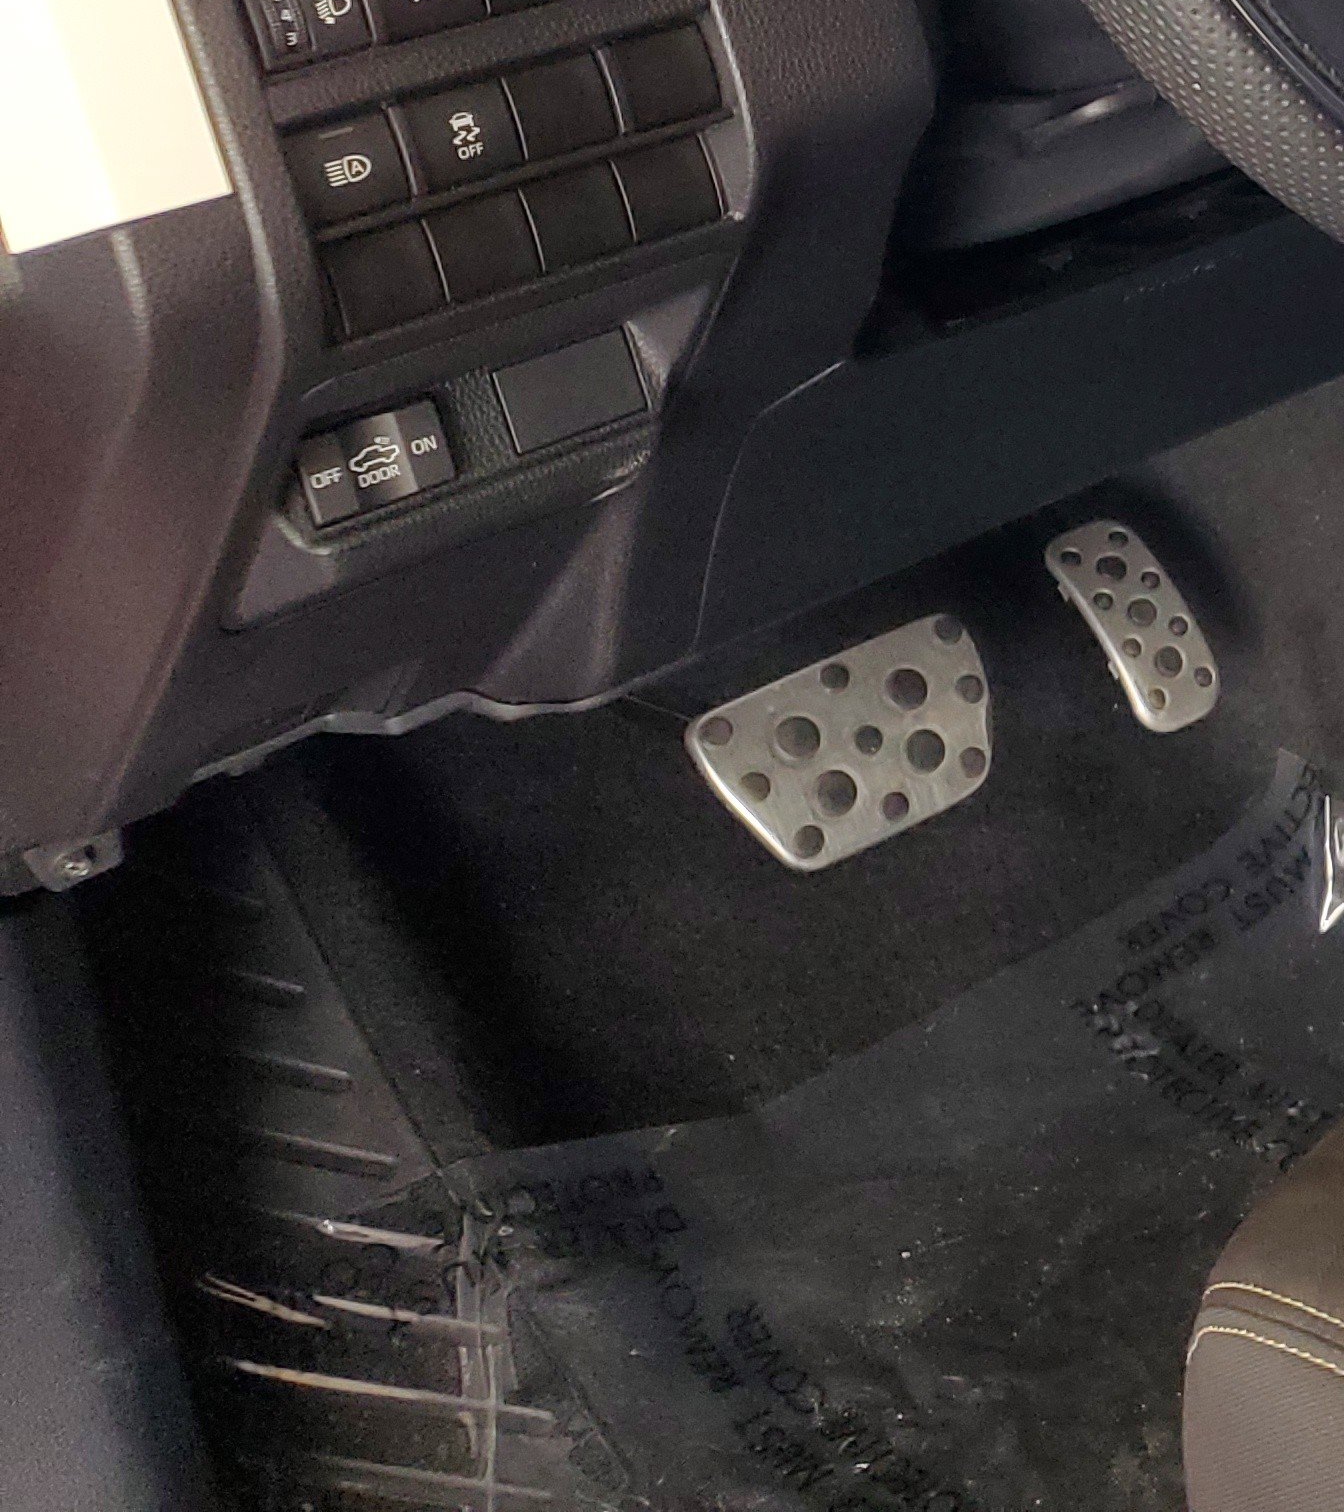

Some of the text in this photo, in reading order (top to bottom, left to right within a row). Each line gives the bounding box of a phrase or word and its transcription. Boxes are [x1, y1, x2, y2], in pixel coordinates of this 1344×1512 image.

[285, 32, 299, 47] 3
[456, 142, 485, 160] OFF
[410, 435, 438, 456] ON
[310, 467, 342, 489] OFF
[358, 464, 401, 489] DOOR
